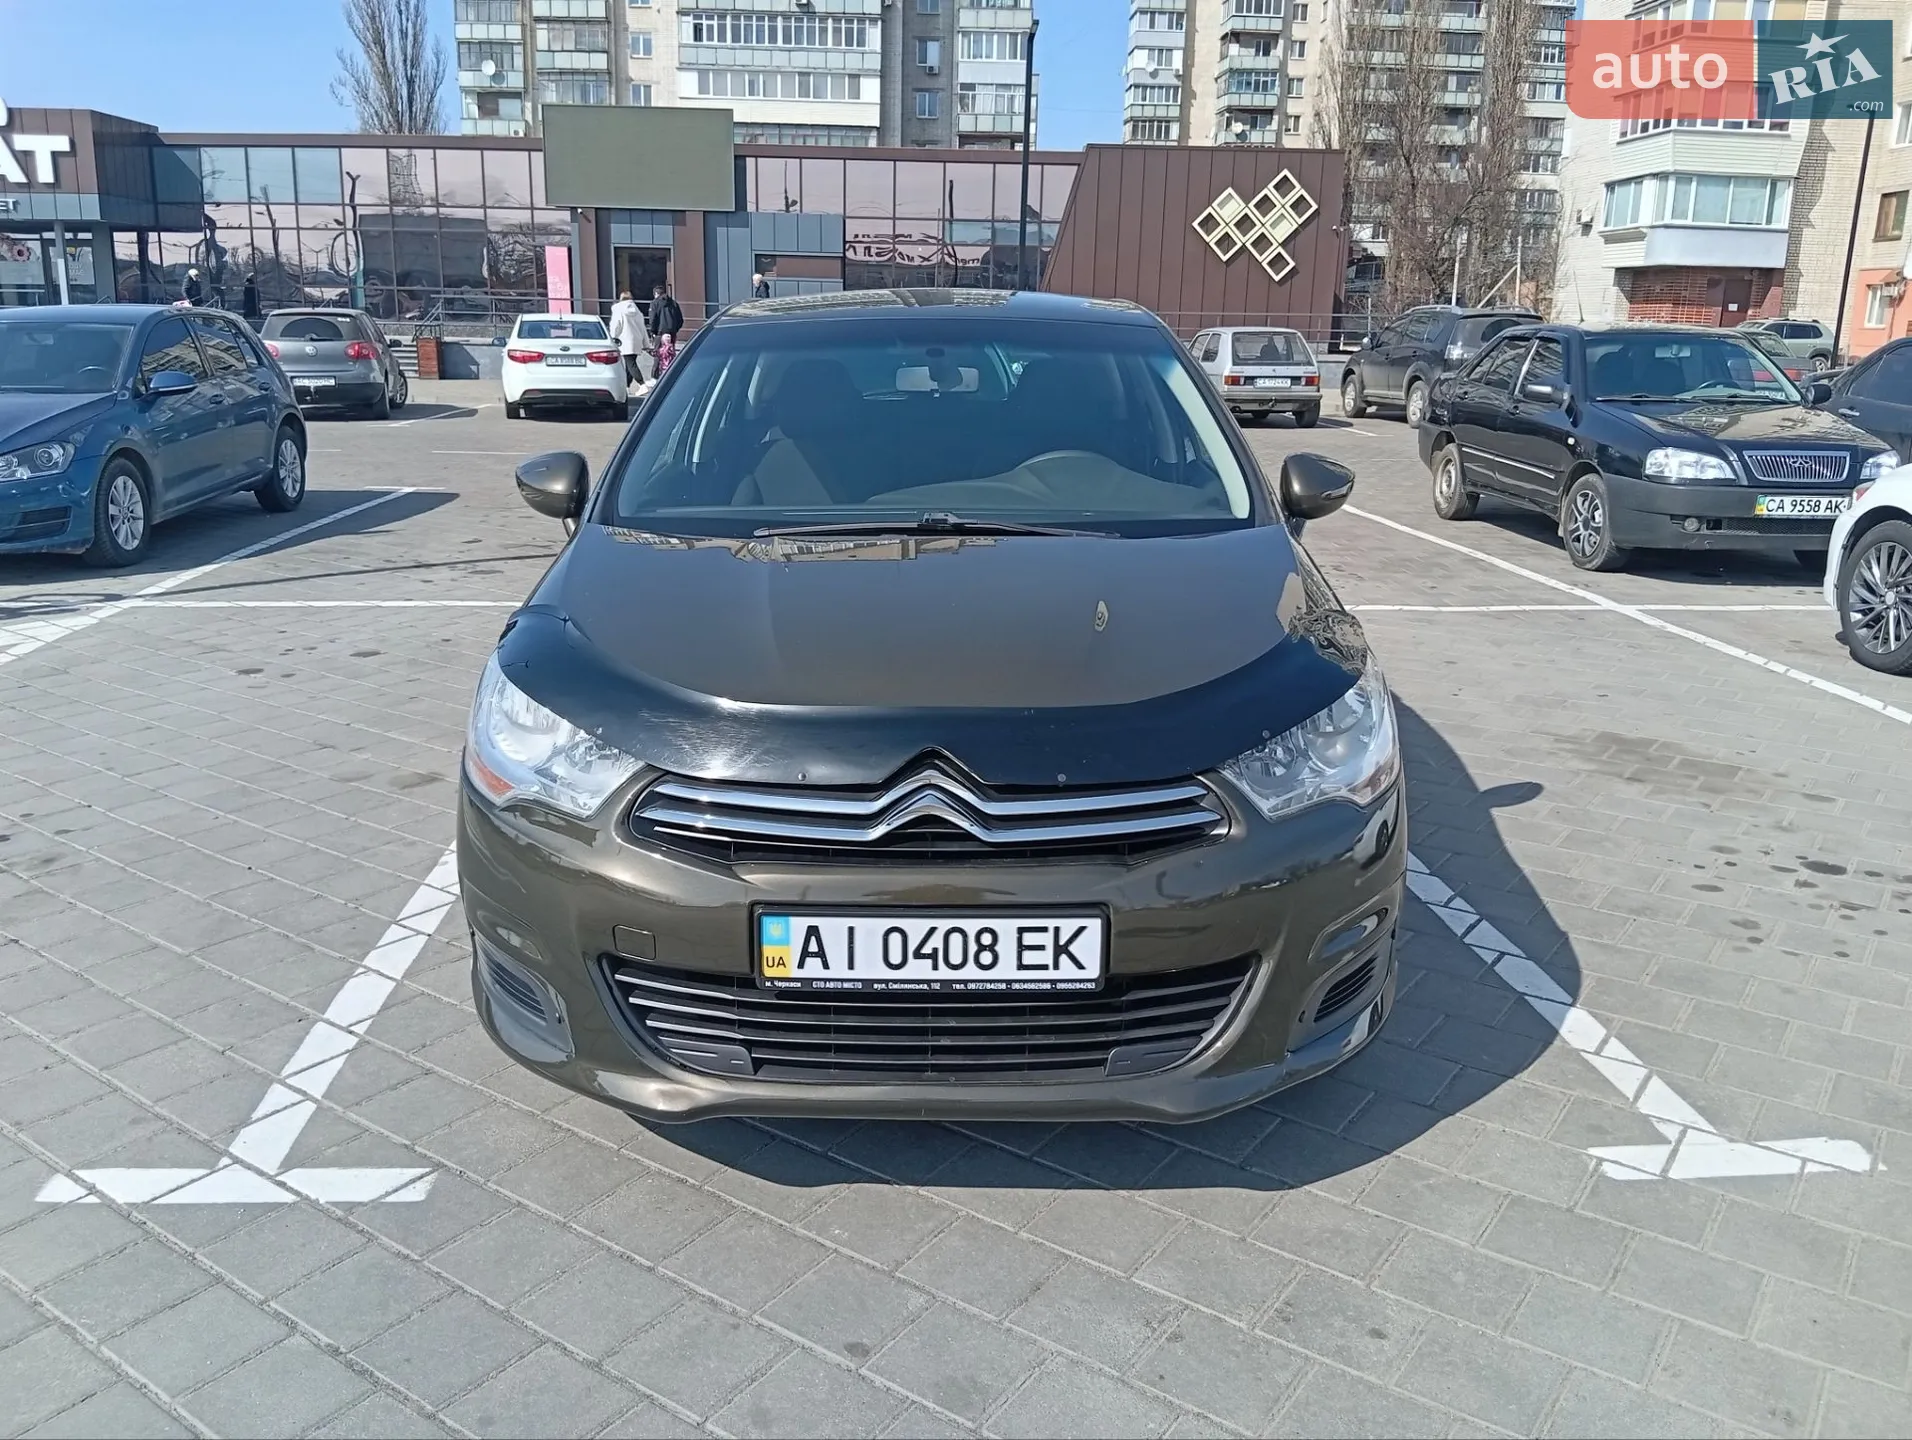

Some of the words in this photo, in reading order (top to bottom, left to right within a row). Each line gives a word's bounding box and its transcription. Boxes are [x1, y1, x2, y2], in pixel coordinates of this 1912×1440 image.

[1766, 499, 1785, 513] CA
[1790, 500, 1821, 513] 9558
[1824, 500, 1844, 514] AK
[797, 925, 855, 970] AI
[882, 926, 999, 971] 0408
[1016, 926, 1088, 970] EK
[766, 956, 786, 968] UA
